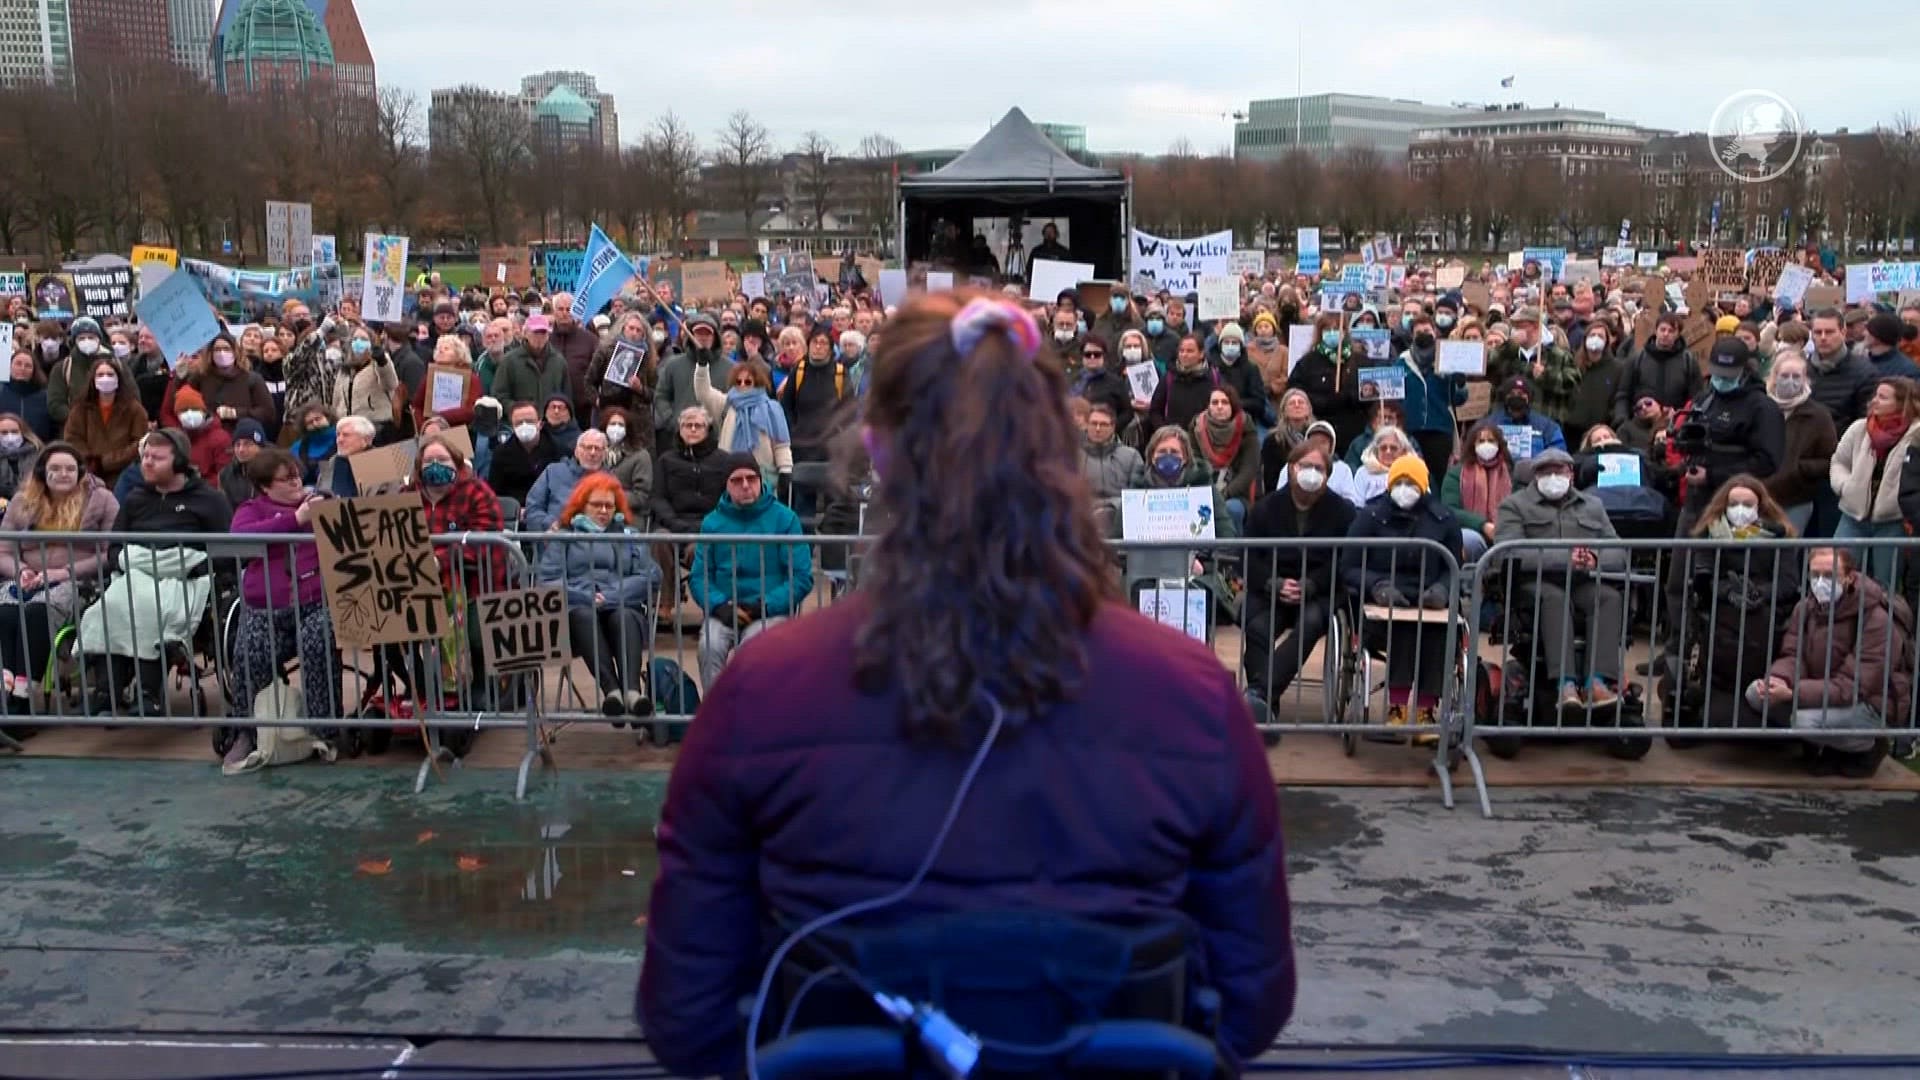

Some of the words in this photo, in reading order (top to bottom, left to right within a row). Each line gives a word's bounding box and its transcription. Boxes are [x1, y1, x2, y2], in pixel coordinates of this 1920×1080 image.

[84, 288, 108, 302] Help
[87, 304, 111, 317] Cure
[320, 499, 378, 554] WE
[380, 506, 430, 551] ARE
[378, 586, 413, 615] OF
[484, 590, 563, 624] ZORG
[492, 620, 563, 659] NU!
